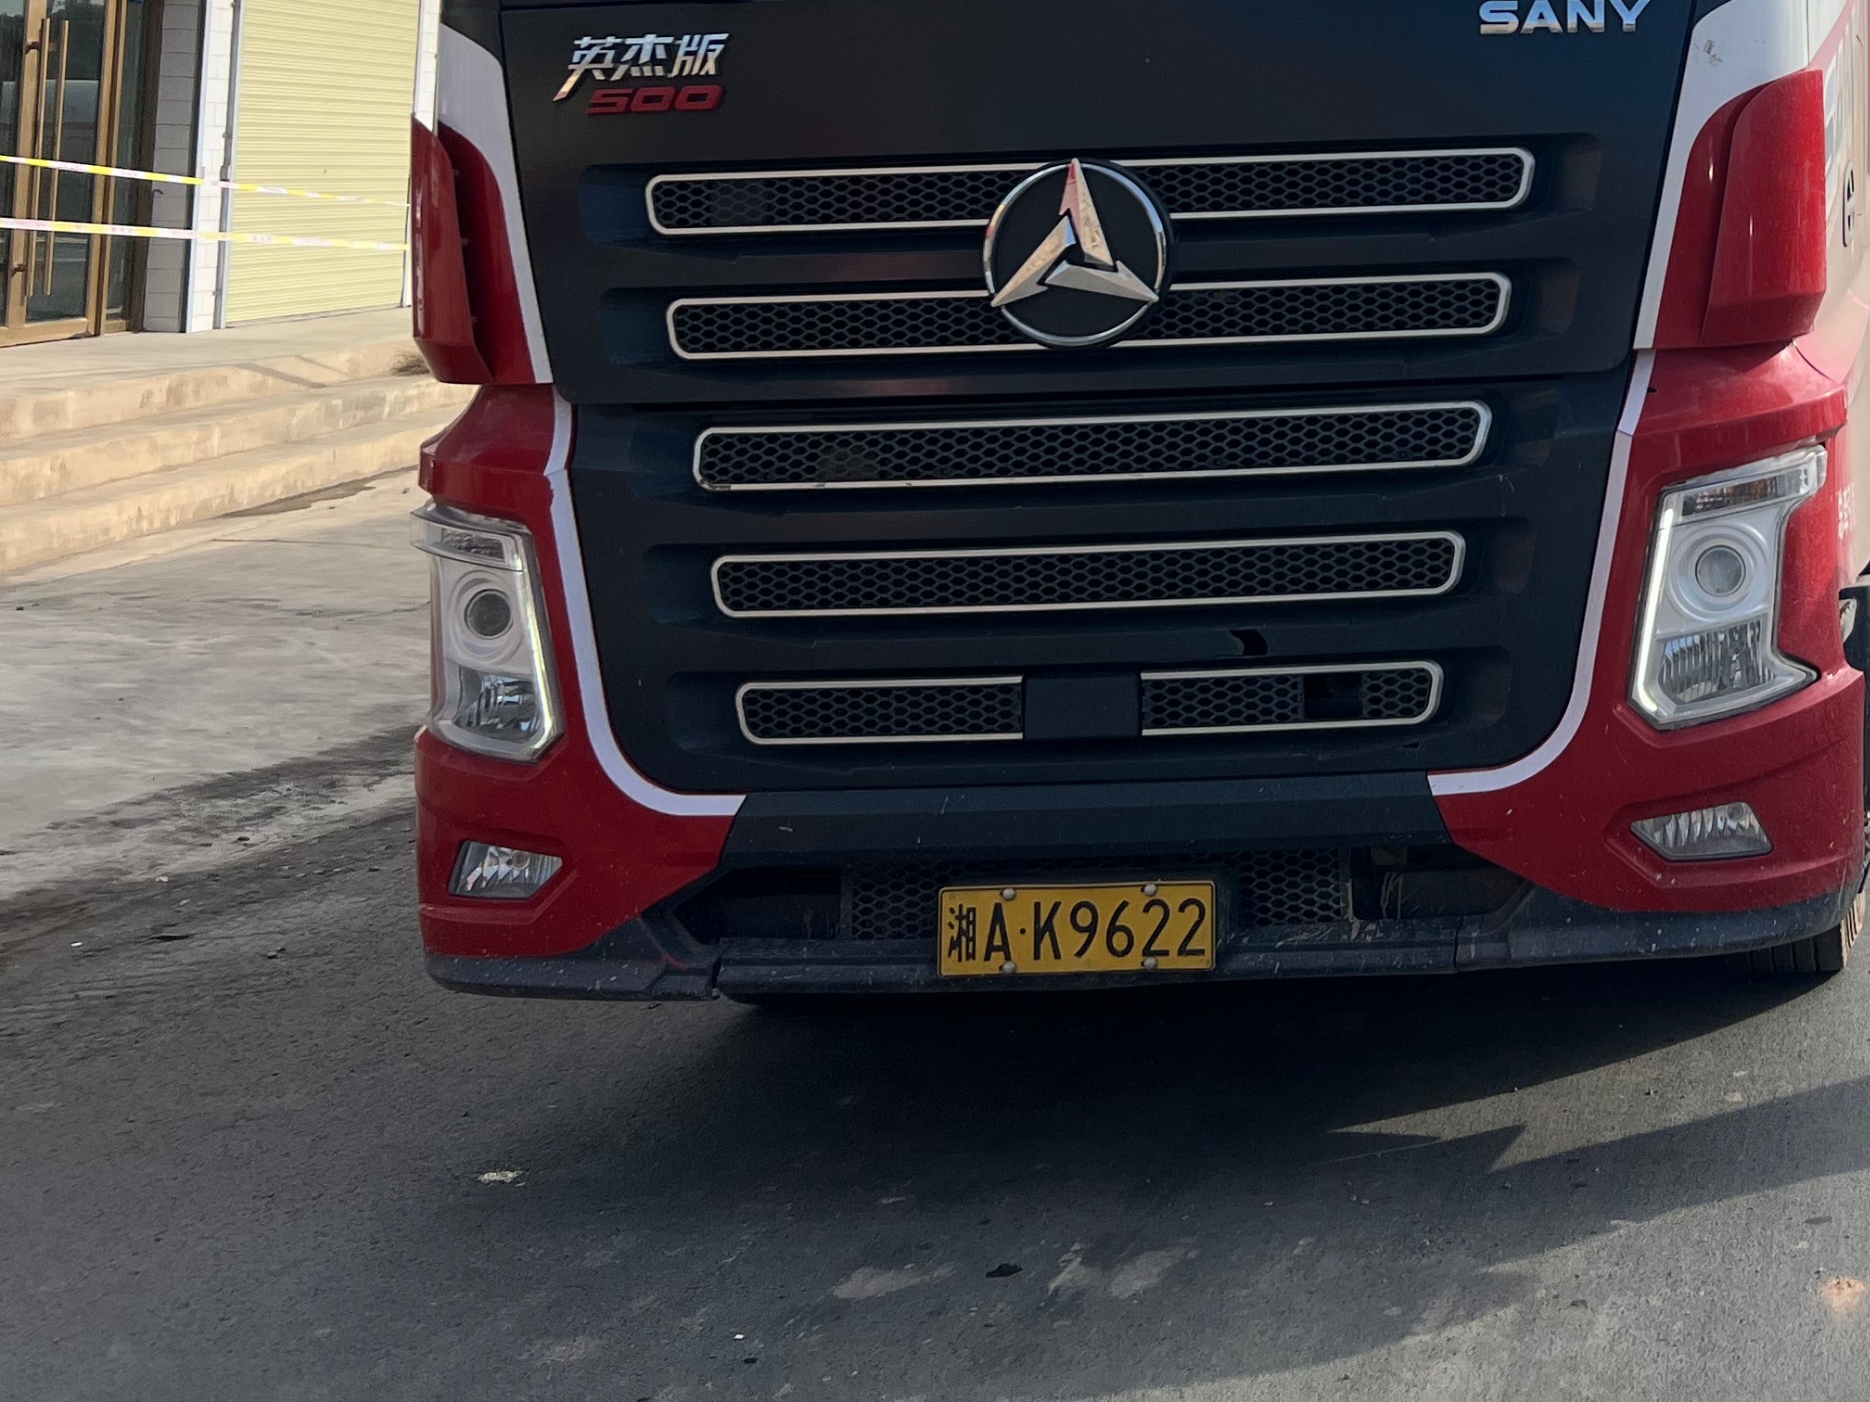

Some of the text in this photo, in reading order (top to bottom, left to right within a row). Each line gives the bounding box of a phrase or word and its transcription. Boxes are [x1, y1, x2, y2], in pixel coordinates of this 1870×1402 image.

[553, 32, 729, 102] 英杰版
[586, 85, 725, 115] 500
